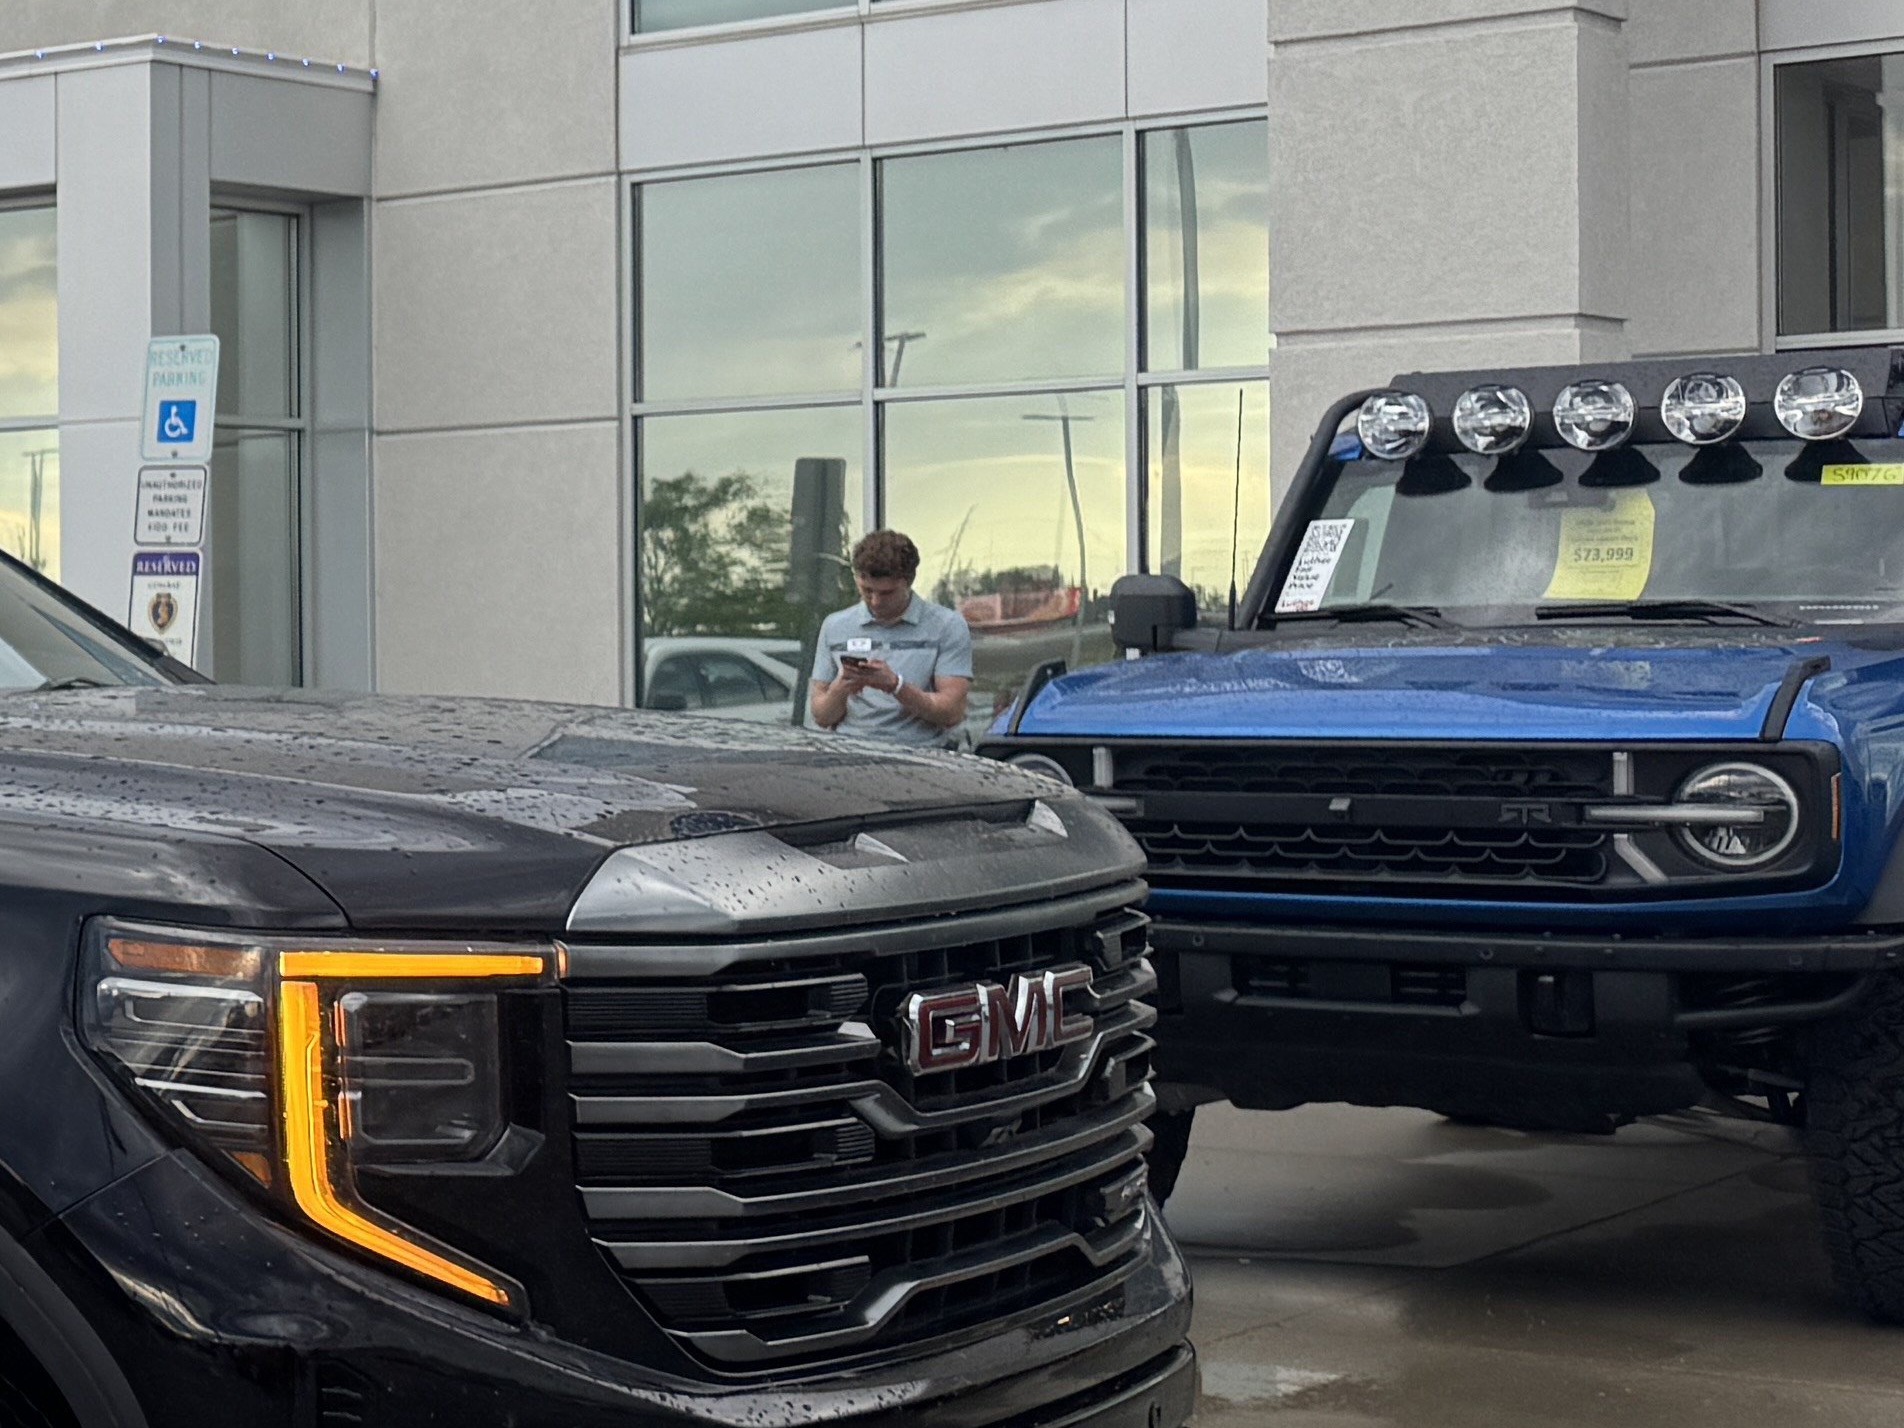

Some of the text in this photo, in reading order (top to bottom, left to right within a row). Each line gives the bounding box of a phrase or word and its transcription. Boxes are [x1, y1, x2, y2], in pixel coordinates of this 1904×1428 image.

[152, 370, 207, 387] PARKING
[152, 494, 188, 504] PARKING
[1573, 547, 1634, 563] $73,999
[136, 559, 196, 575] RESERVED
[901, 962, 1094, 1077] GMC
